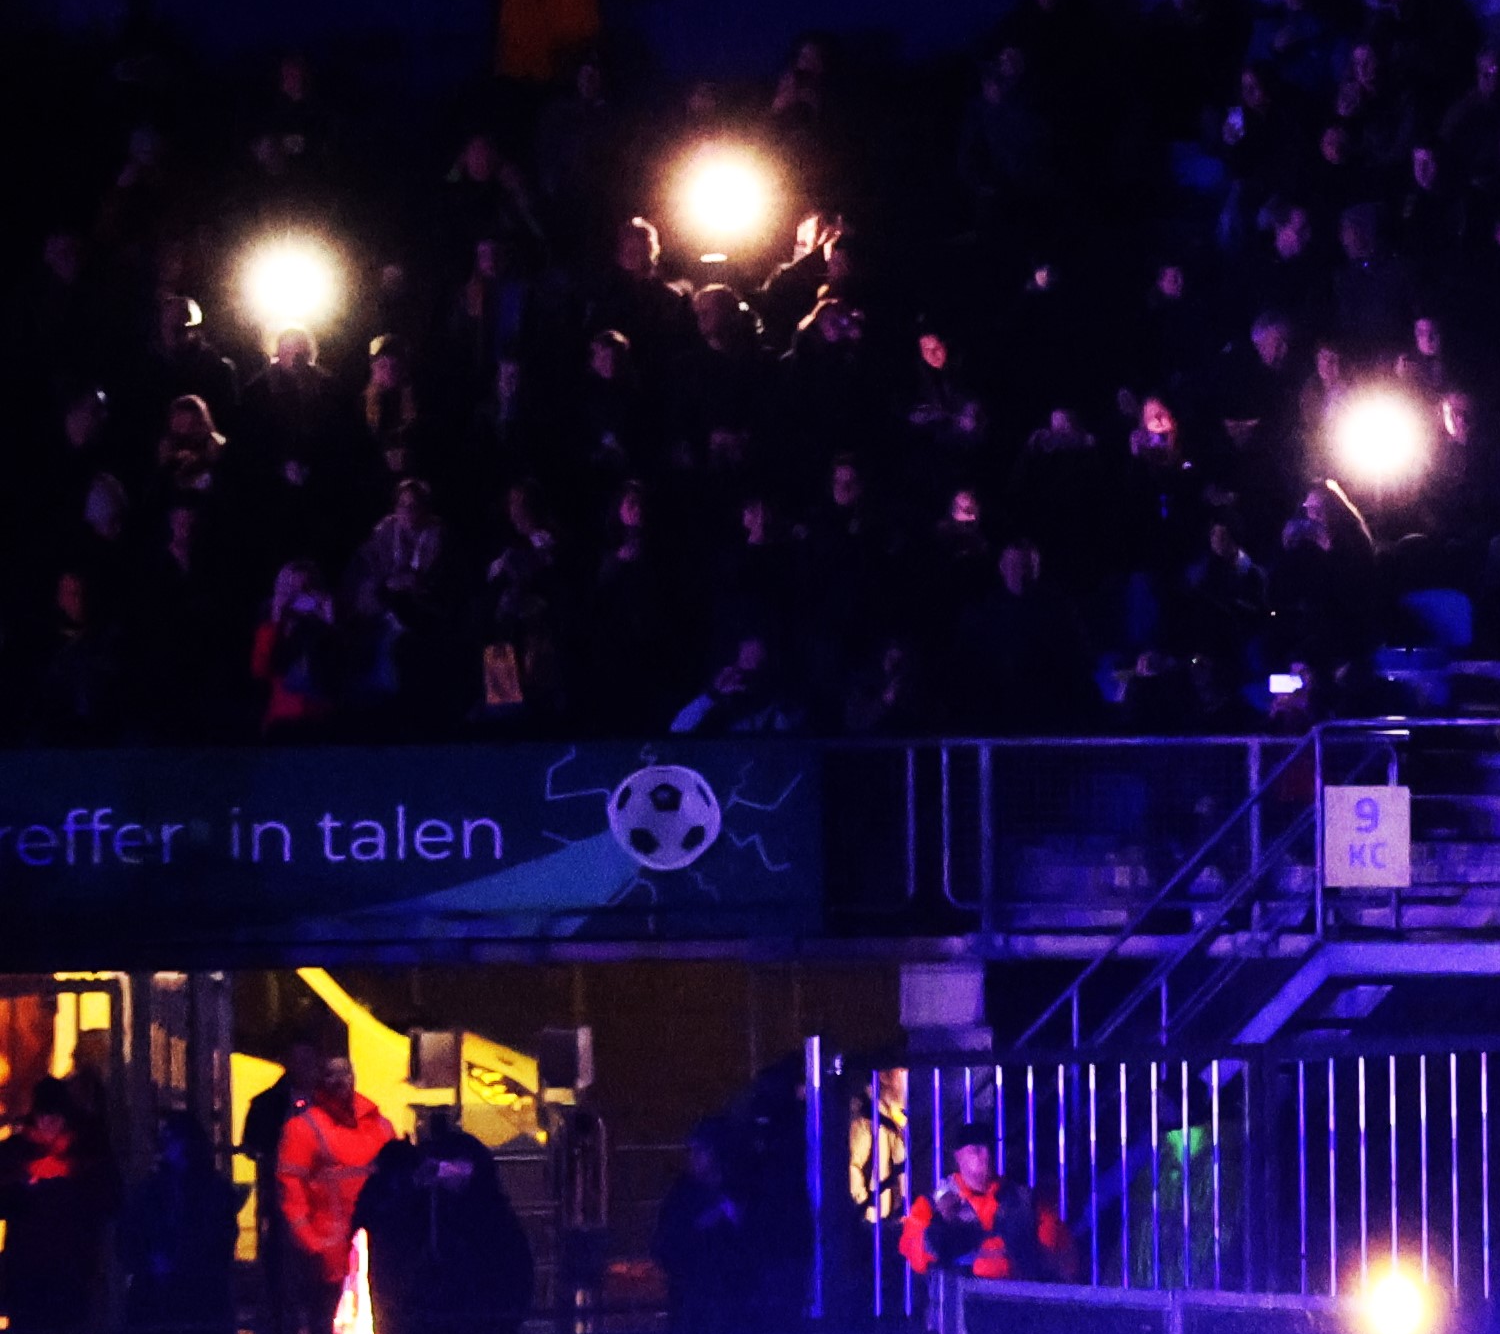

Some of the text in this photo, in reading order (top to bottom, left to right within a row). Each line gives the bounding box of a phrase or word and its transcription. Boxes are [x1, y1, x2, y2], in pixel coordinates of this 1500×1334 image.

[231, 805, 291, 862] in
[320, 805, 504, 863] talen
[1355, 797, 1380, 834] 9
